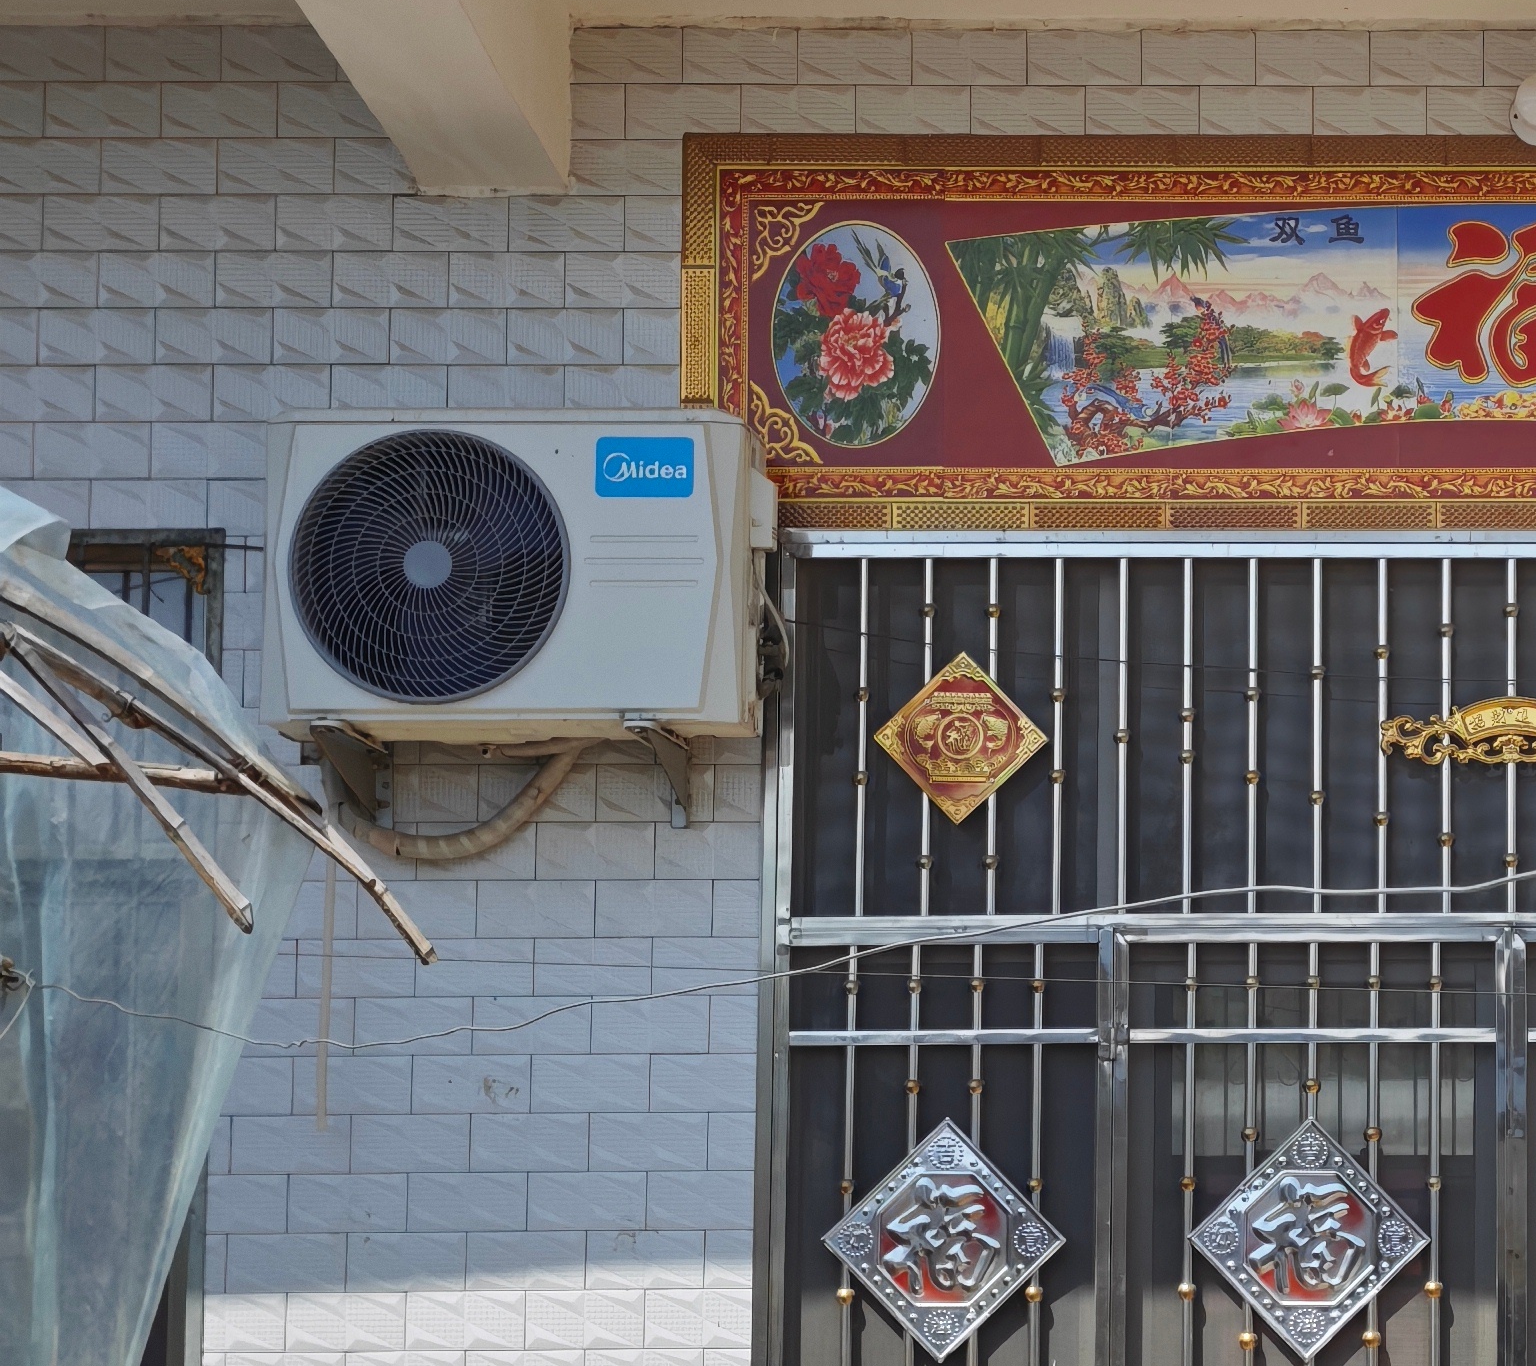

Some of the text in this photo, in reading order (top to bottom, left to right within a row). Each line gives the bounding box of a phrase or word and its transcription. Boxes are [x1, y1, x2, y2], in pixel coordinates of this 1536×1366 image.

[1269, 214, 1365, 245] 双鱼
[603, 452, 687, 482] Midea
[882, 1176, 1001, 1297] 福
[1248, 1176, 1367, 1294] 福
